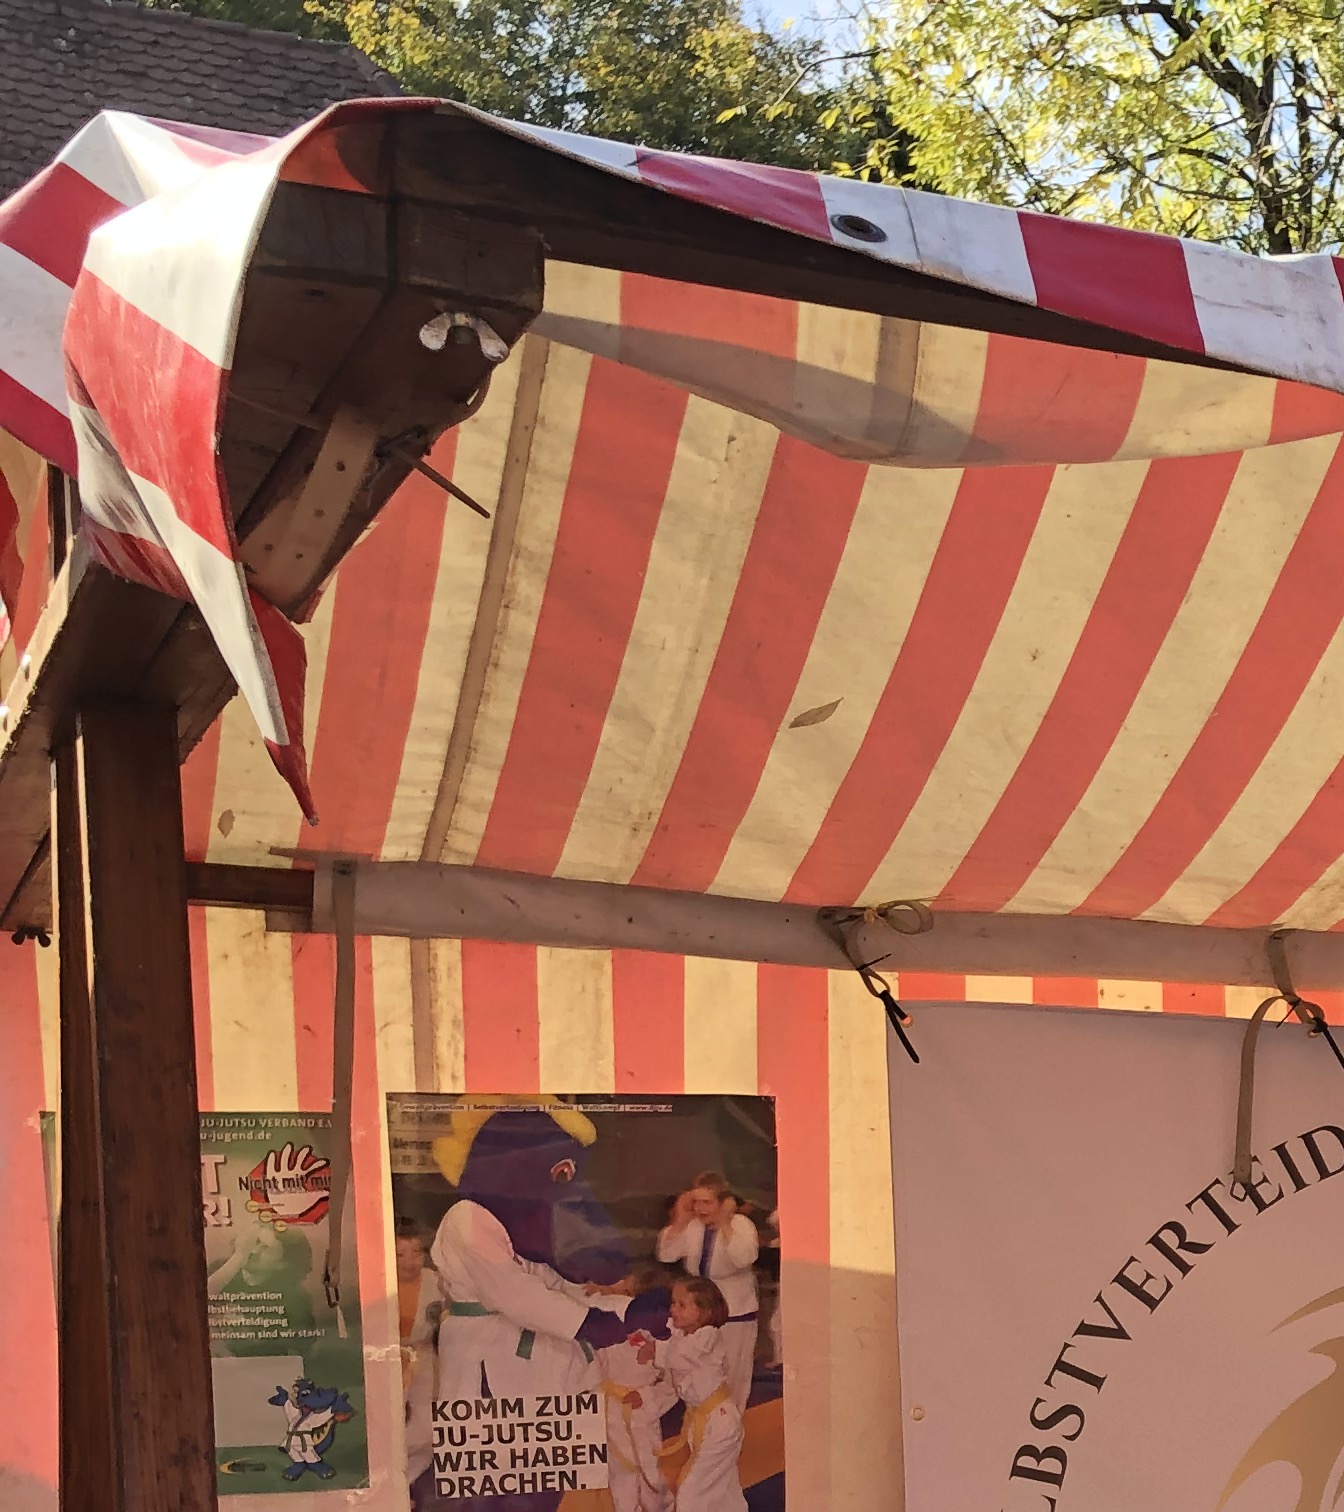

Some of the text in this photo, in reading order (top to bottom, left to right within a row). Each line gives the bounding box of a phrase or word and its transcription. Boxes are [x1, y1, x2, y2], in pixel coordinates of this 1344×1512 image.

[239, 1176, 279, 1191] Nicht
[282, 1174, 305, 1190] mit
[208, 1292, 283, 1302] waltprävention
[211, 1331, 256, 1339] meinsam
[432, 1393, 599, 1422] KOMM ZUM
[432, 1420, 582, 1447] JU-JUTSU.
[433, 1443, 608, 1473] WIR HABEN
[436, 1470, 587, 1498] DRACHEN.
